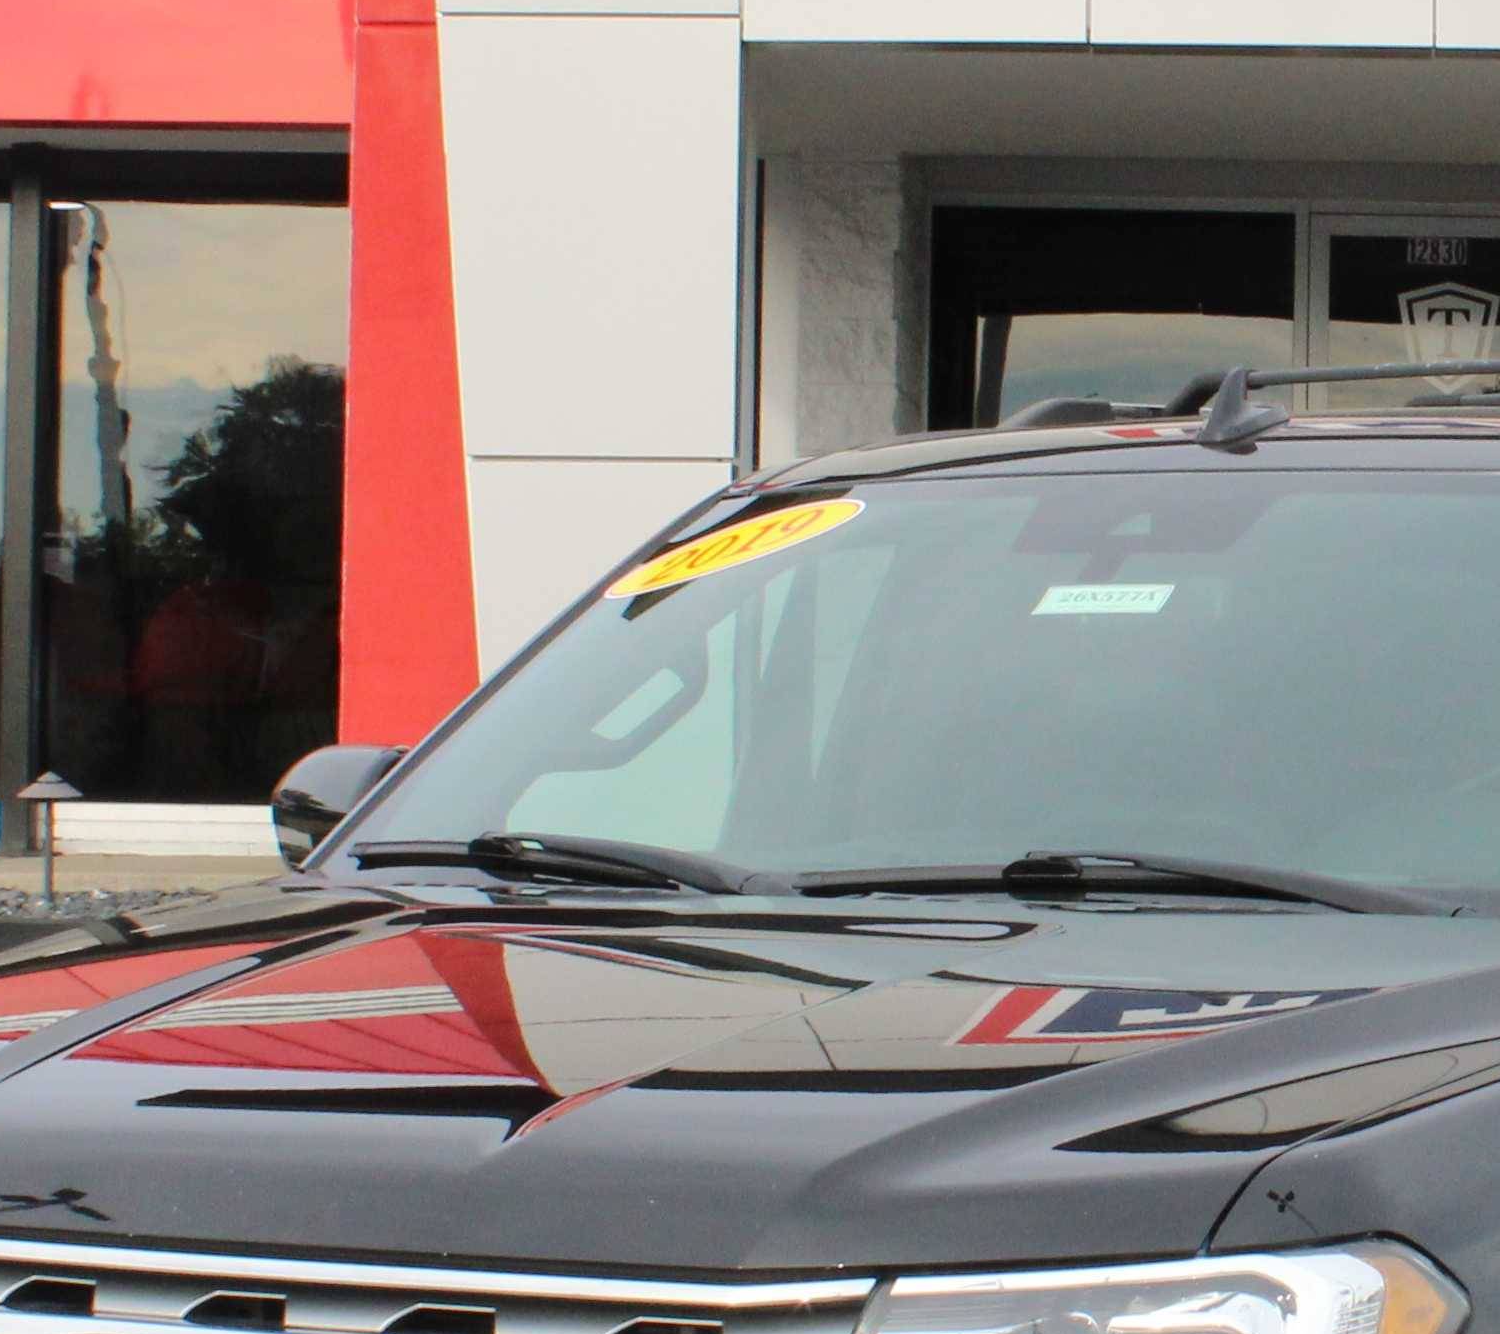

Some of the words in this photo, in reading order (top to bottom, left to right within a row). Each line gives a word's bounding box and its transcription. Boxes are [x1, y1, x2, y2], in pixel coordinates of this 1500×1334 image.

[1407, 238, 1468, 265] 12830
[1427, 307, 1471, 358] T
[641, 508, 825, 587] 2019
